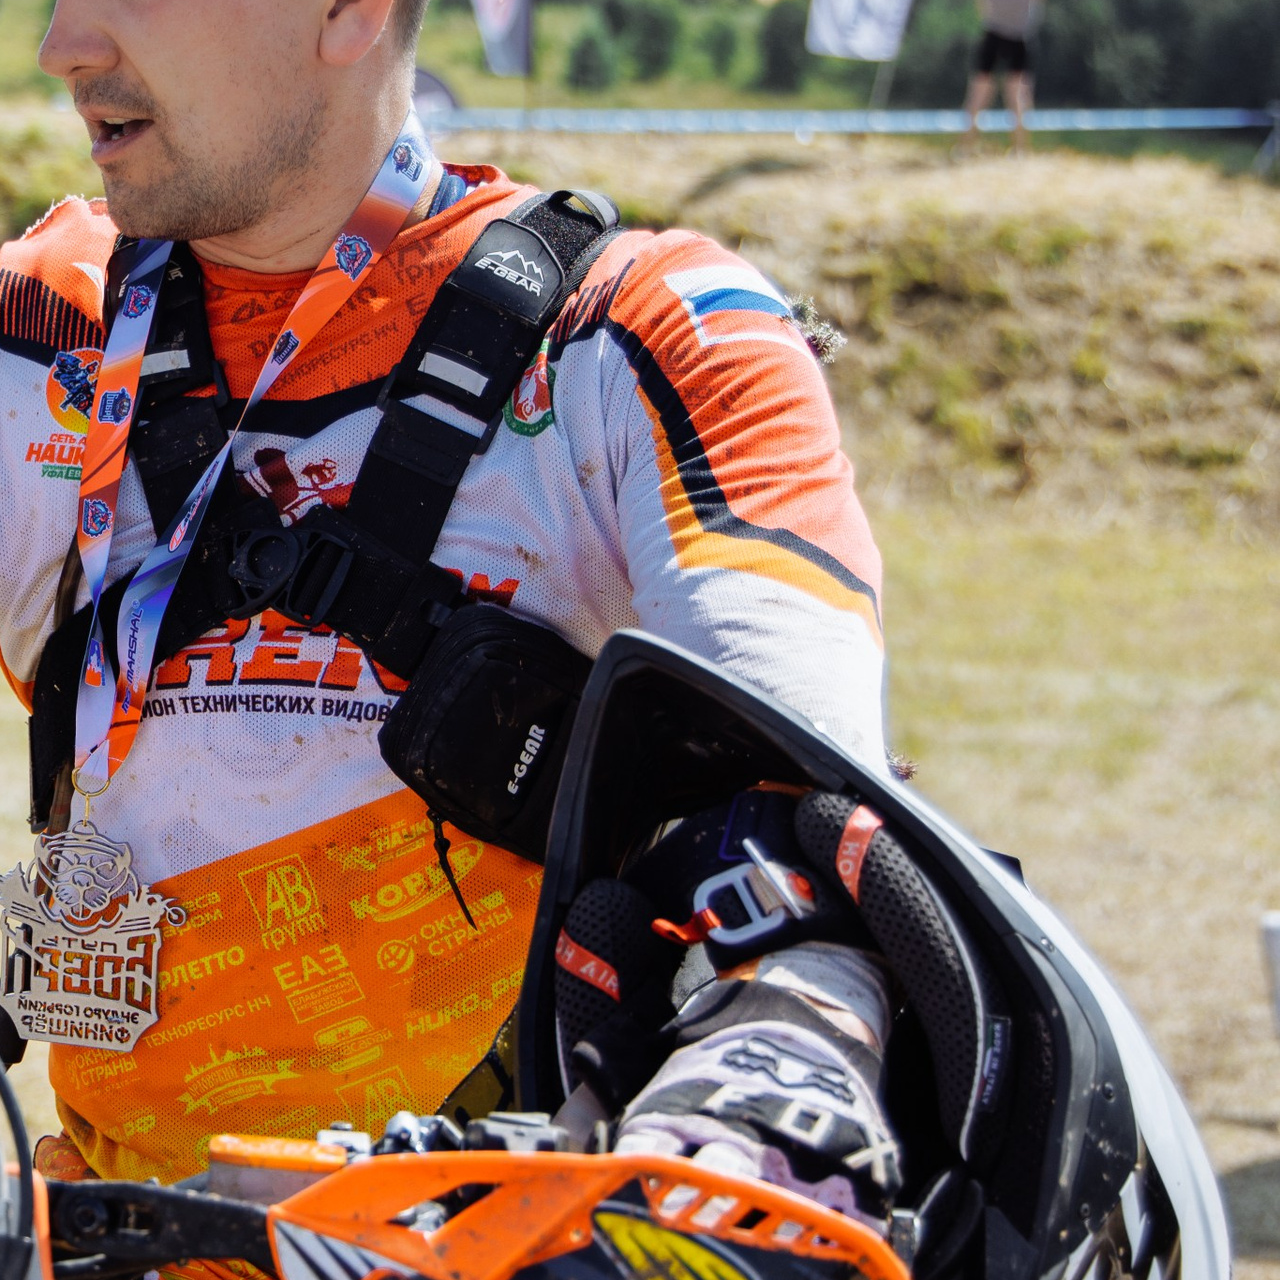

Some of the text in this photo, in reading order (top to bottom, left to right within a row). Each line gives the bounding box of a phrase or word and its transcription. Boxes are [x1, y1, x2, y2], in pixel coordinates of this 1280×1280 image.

[474, 258, 543, 297] E-GEAR
[49, 433, 76, 444] СЕТЬ
[41, 469, 64, 480] УФА
[127, 608, 142, 684] MARSHAL
[180, 694, 315, 716] ТЕХНИЧЕСКИХ
[321, 698, 393, 722] ВИДОВ
[508, 723, 546, 796] E-GEAR
[268, 863, 313, 929] АВ
[260, 912, 327, 950] групп
[427, 906, 514, 957] СТРАНЫ
[156, 944, 248, 992] РЛЕТТО
[143, 995, 272, 1049] ТЕХНОРЕСУРС НЧ
[312, 996, 345, 1014] ЗАВОД
[80, 1055, 138, 1086] СТРАНЫ
[982, 1073, 996, 1104] ITALY
